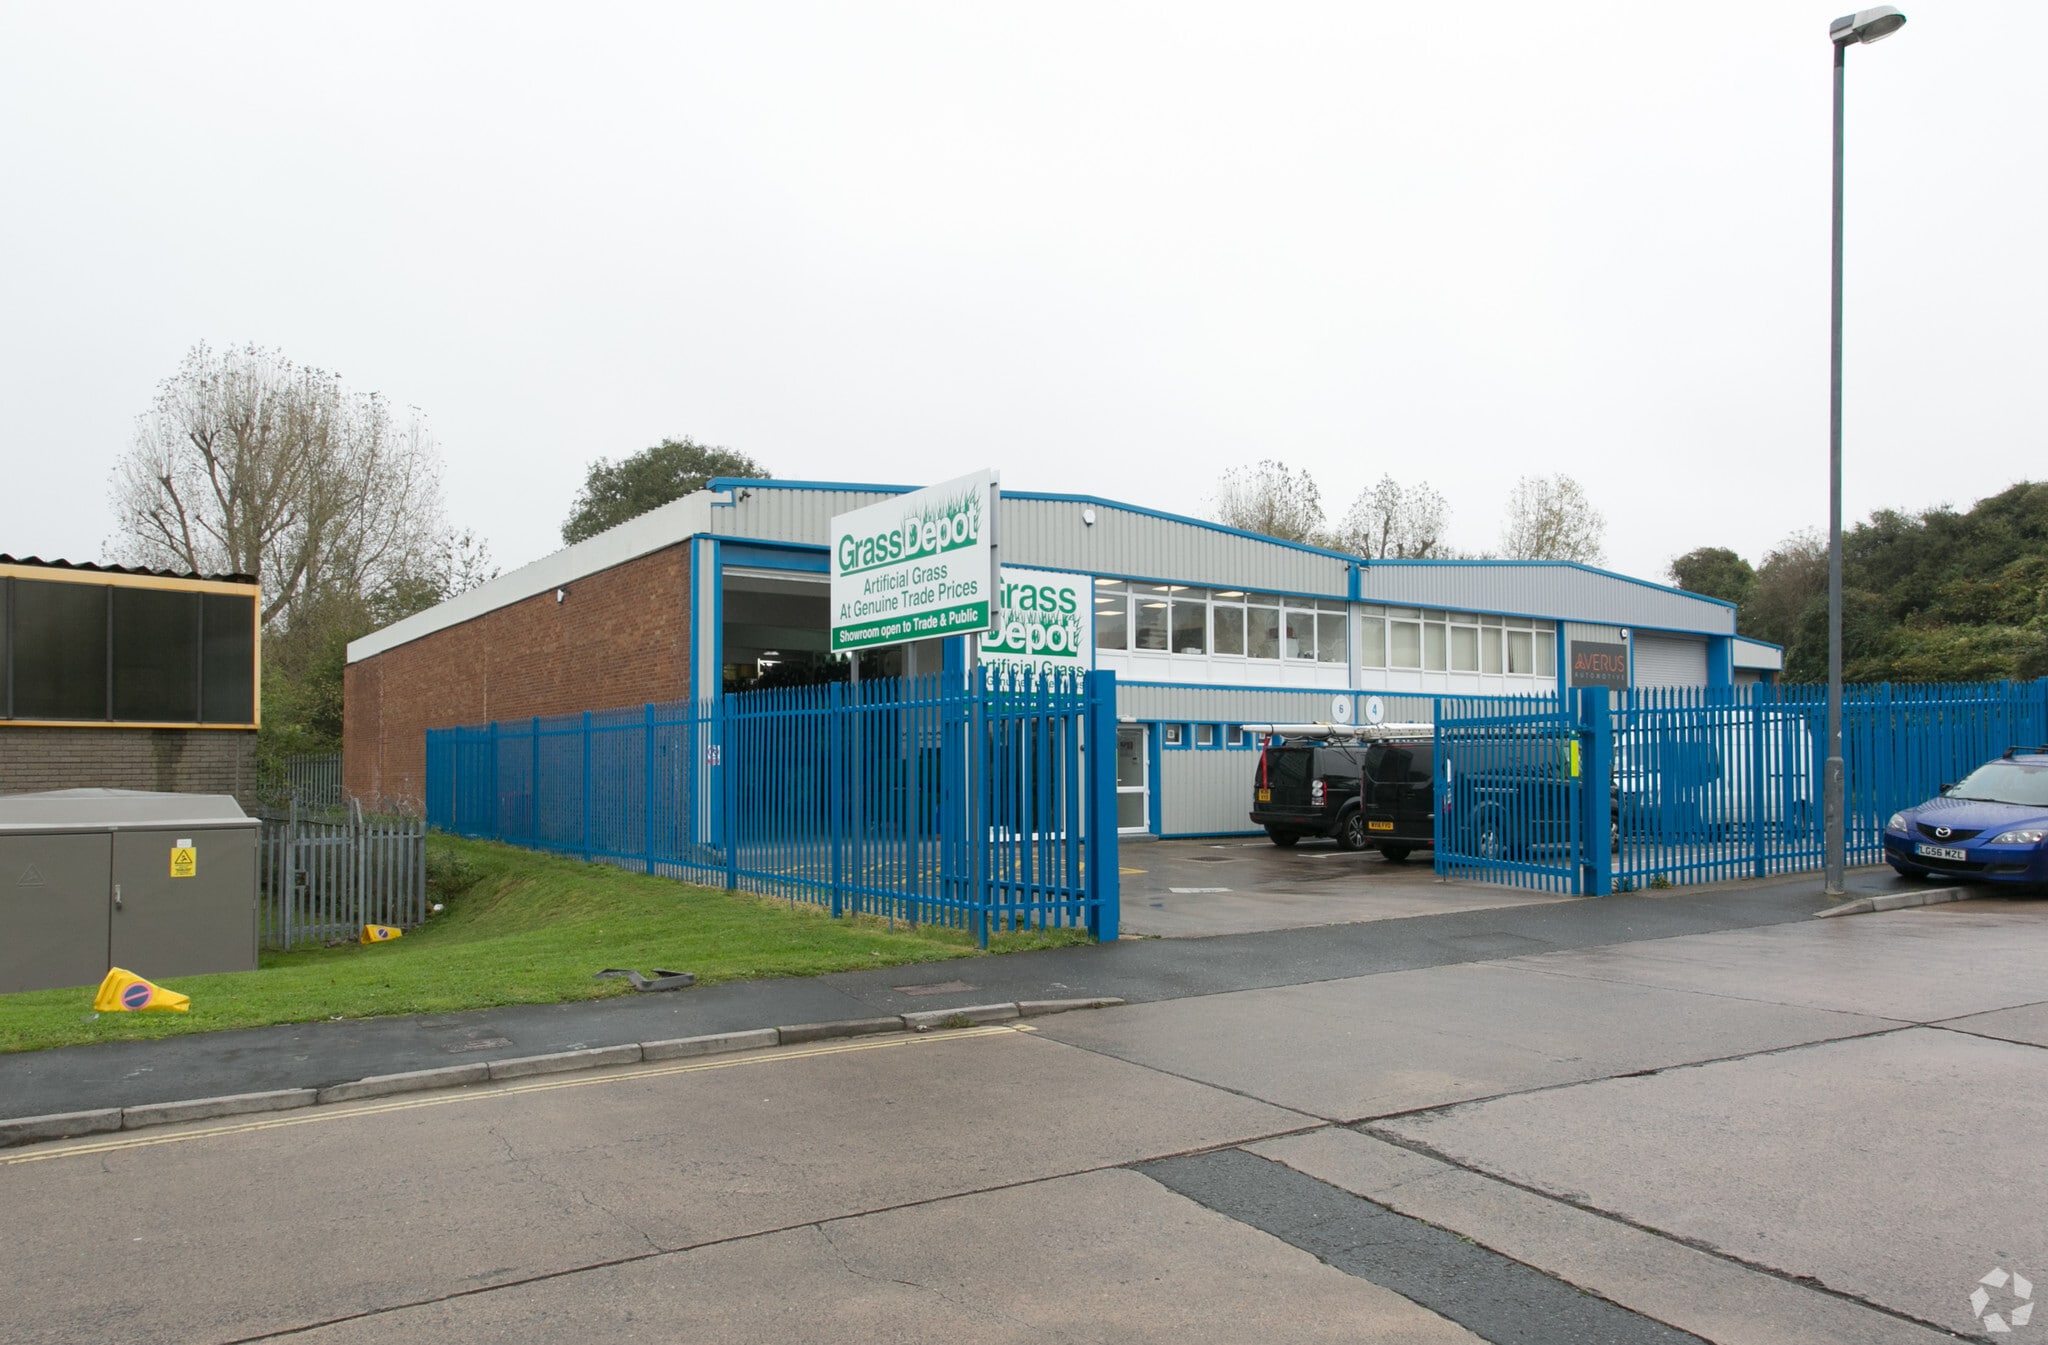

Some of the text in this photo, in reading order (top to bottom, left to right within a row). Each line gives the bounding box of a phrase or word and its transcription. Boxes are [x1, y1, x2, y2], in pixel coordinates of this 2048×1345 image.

[864, 565, 948, 595] Artificial Grass
[840, 580, 978, 620] At Genuine Trade Prices
[1000, 576, 1077, 614] rass
[839, 608, 978, 643] Showroom open to Trade & Public
[1041, 660, 1085, 678] Grass
[1574, 653, 1625, 672] AVERUS
[1574, 671, 1625, 681] AUTOMOTIVE
[1339, 704, 1344, 714] 6
[1372, 704, 1377, 715] 4
[1920, 846, 1942, 857] LG56
